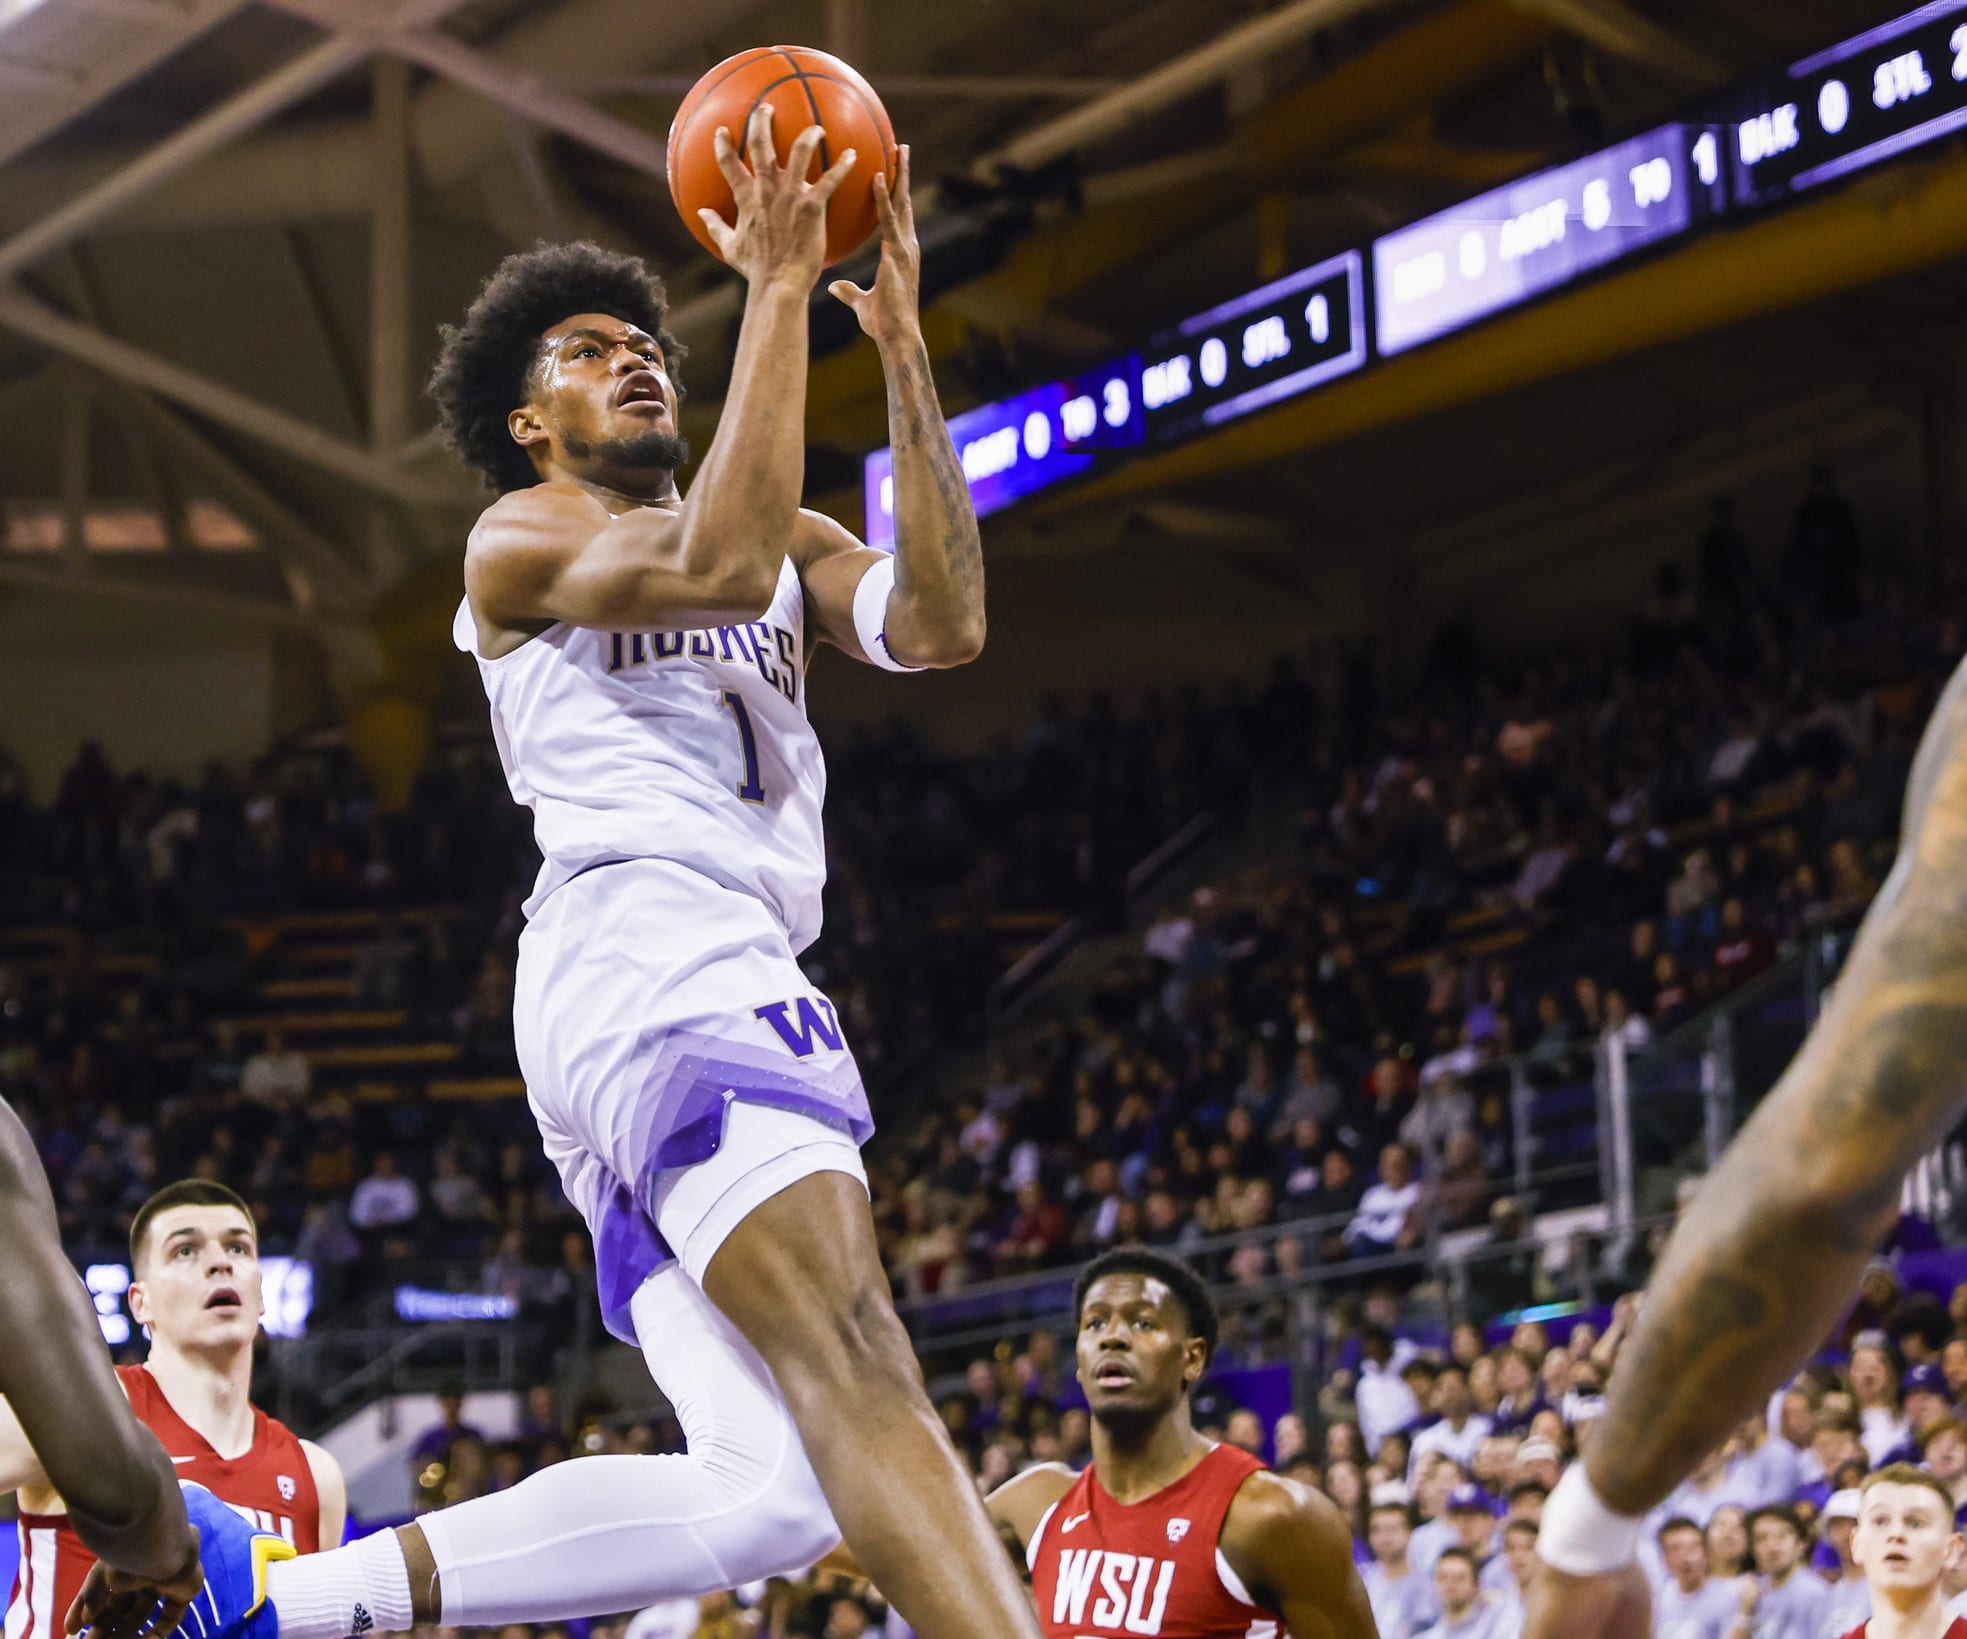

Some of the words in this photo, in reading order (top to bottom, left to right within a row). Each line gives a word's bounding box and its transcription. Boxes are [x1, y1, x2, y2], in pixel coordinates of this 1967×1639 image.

[1692, 131, 1718, 185] 1
[1818, 80, 1849, 134] 0
[1024, 411, 1050, 459] 0
[1103, 378, 1130, 427] 3
[1200, 338, 1227, 387] 0
[1305, 295, 1329, 343] 1
[720, 687, 766, 806] 1
[752, 996, 848, 1062] W
[1053, 1548, 1176, 1636] WSU
